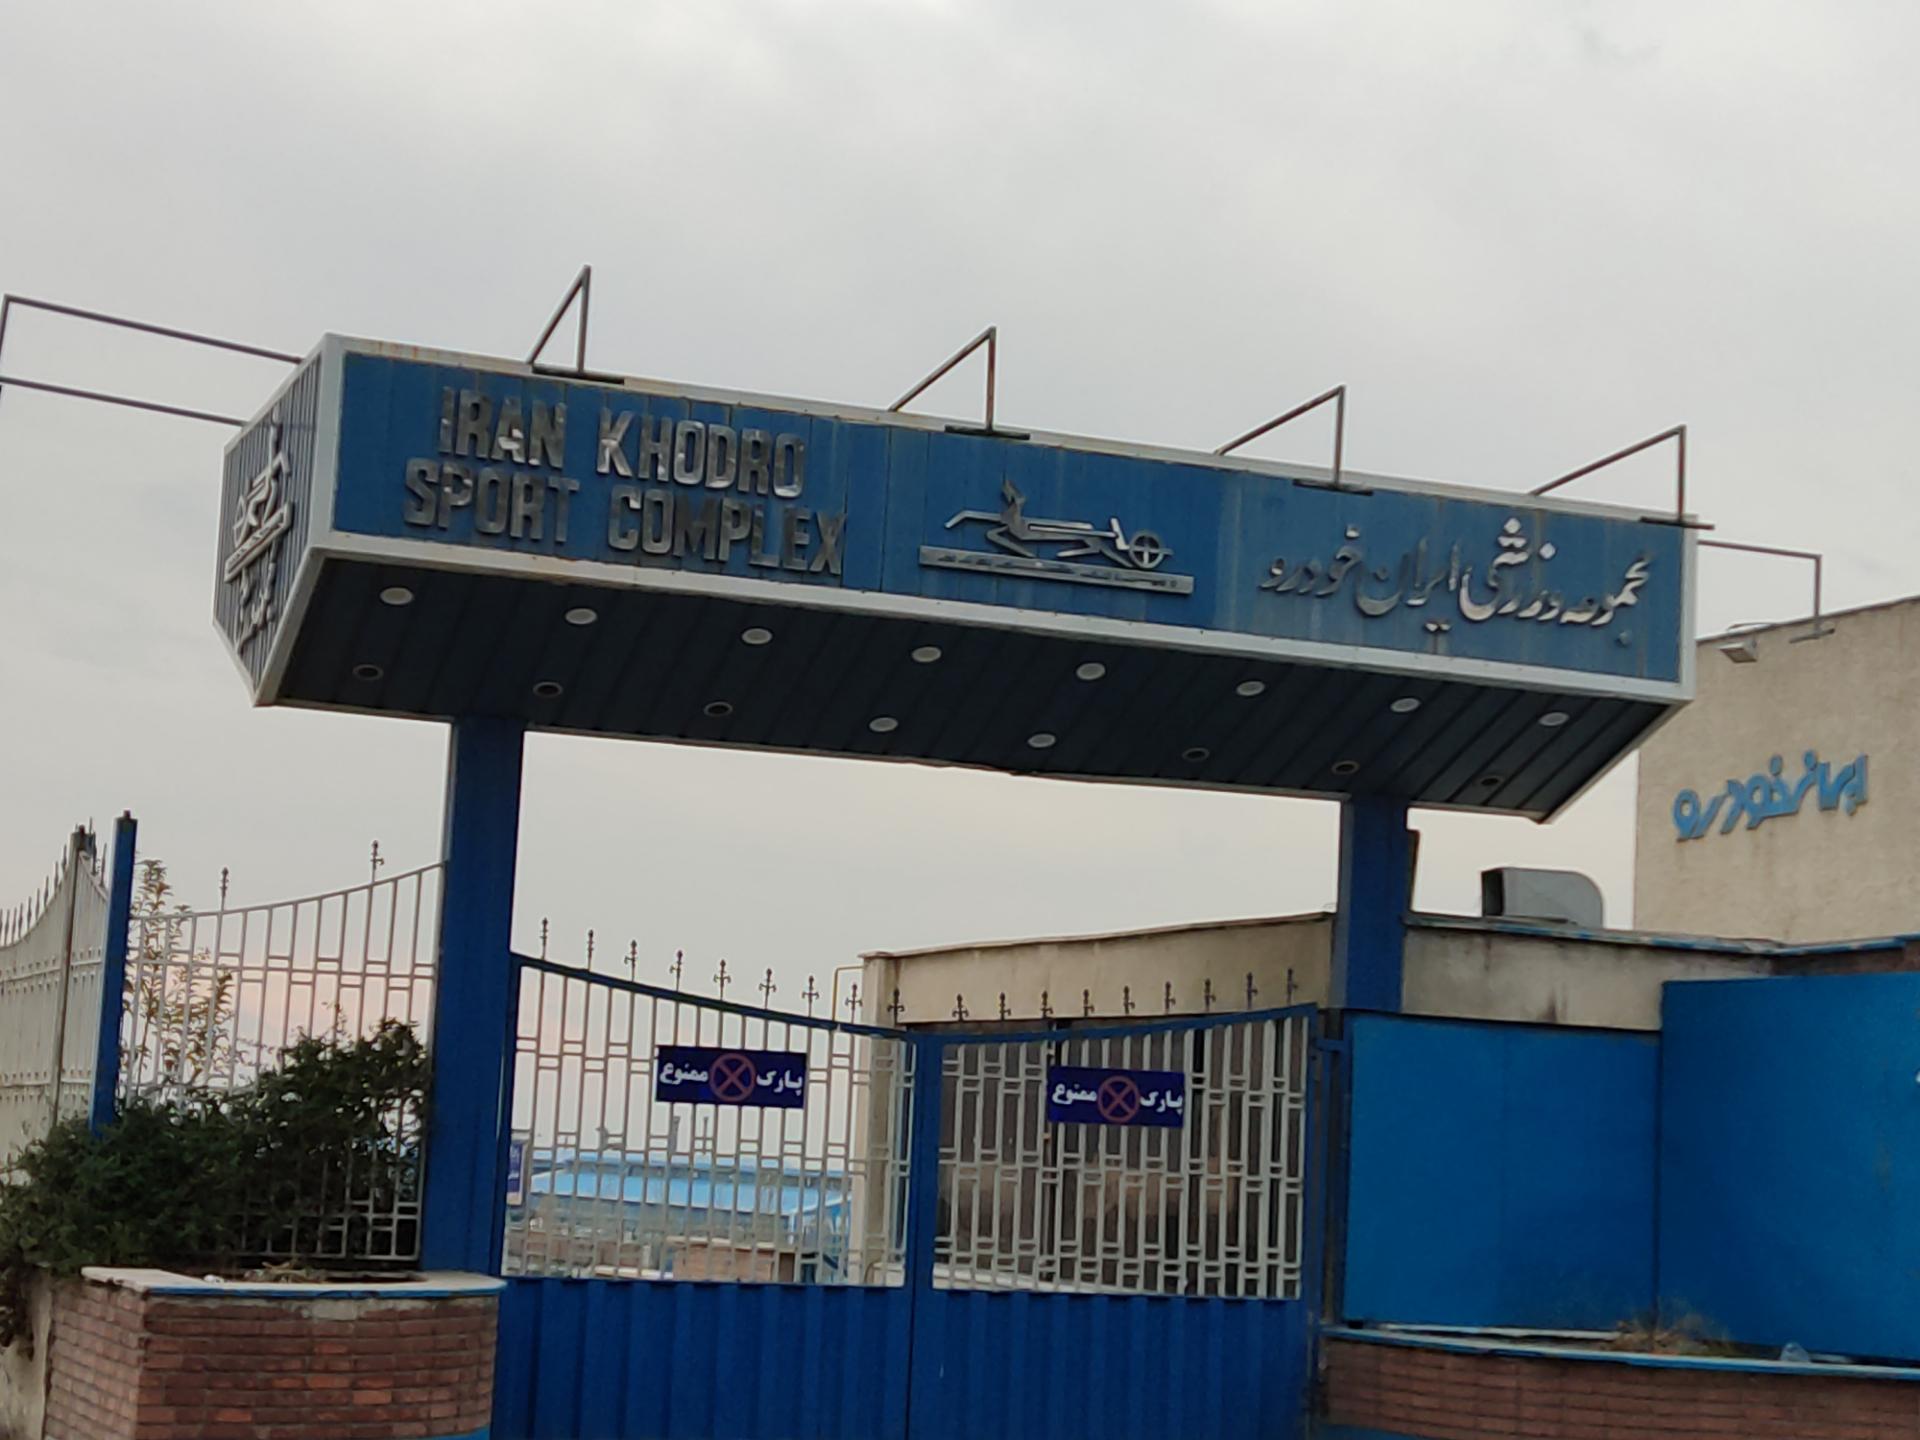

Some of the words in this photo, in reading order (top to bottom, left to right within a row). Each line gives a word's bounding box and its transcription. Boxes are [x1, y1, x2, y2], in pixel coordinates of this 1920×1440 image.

[437, 384, 567, 469] IRAN
[596, 407, 805, 499] KHODRO
[403, 457, 580, 544] SPORT
[607, 484, 848, 576] COMPLEX
[1257, 523, 1365, 598] خودرو
[1355, 537, 1461, 633] ایران
[1458, 516, 1564, 623] ورزشی
[659, 1061, 710, 1085] ممنوع
[755, 1067, 804, 1096] پارک
[1052, 1082, 1099, 1106] ممنوع
[1139, 1090, 1185, 1117] پارک
